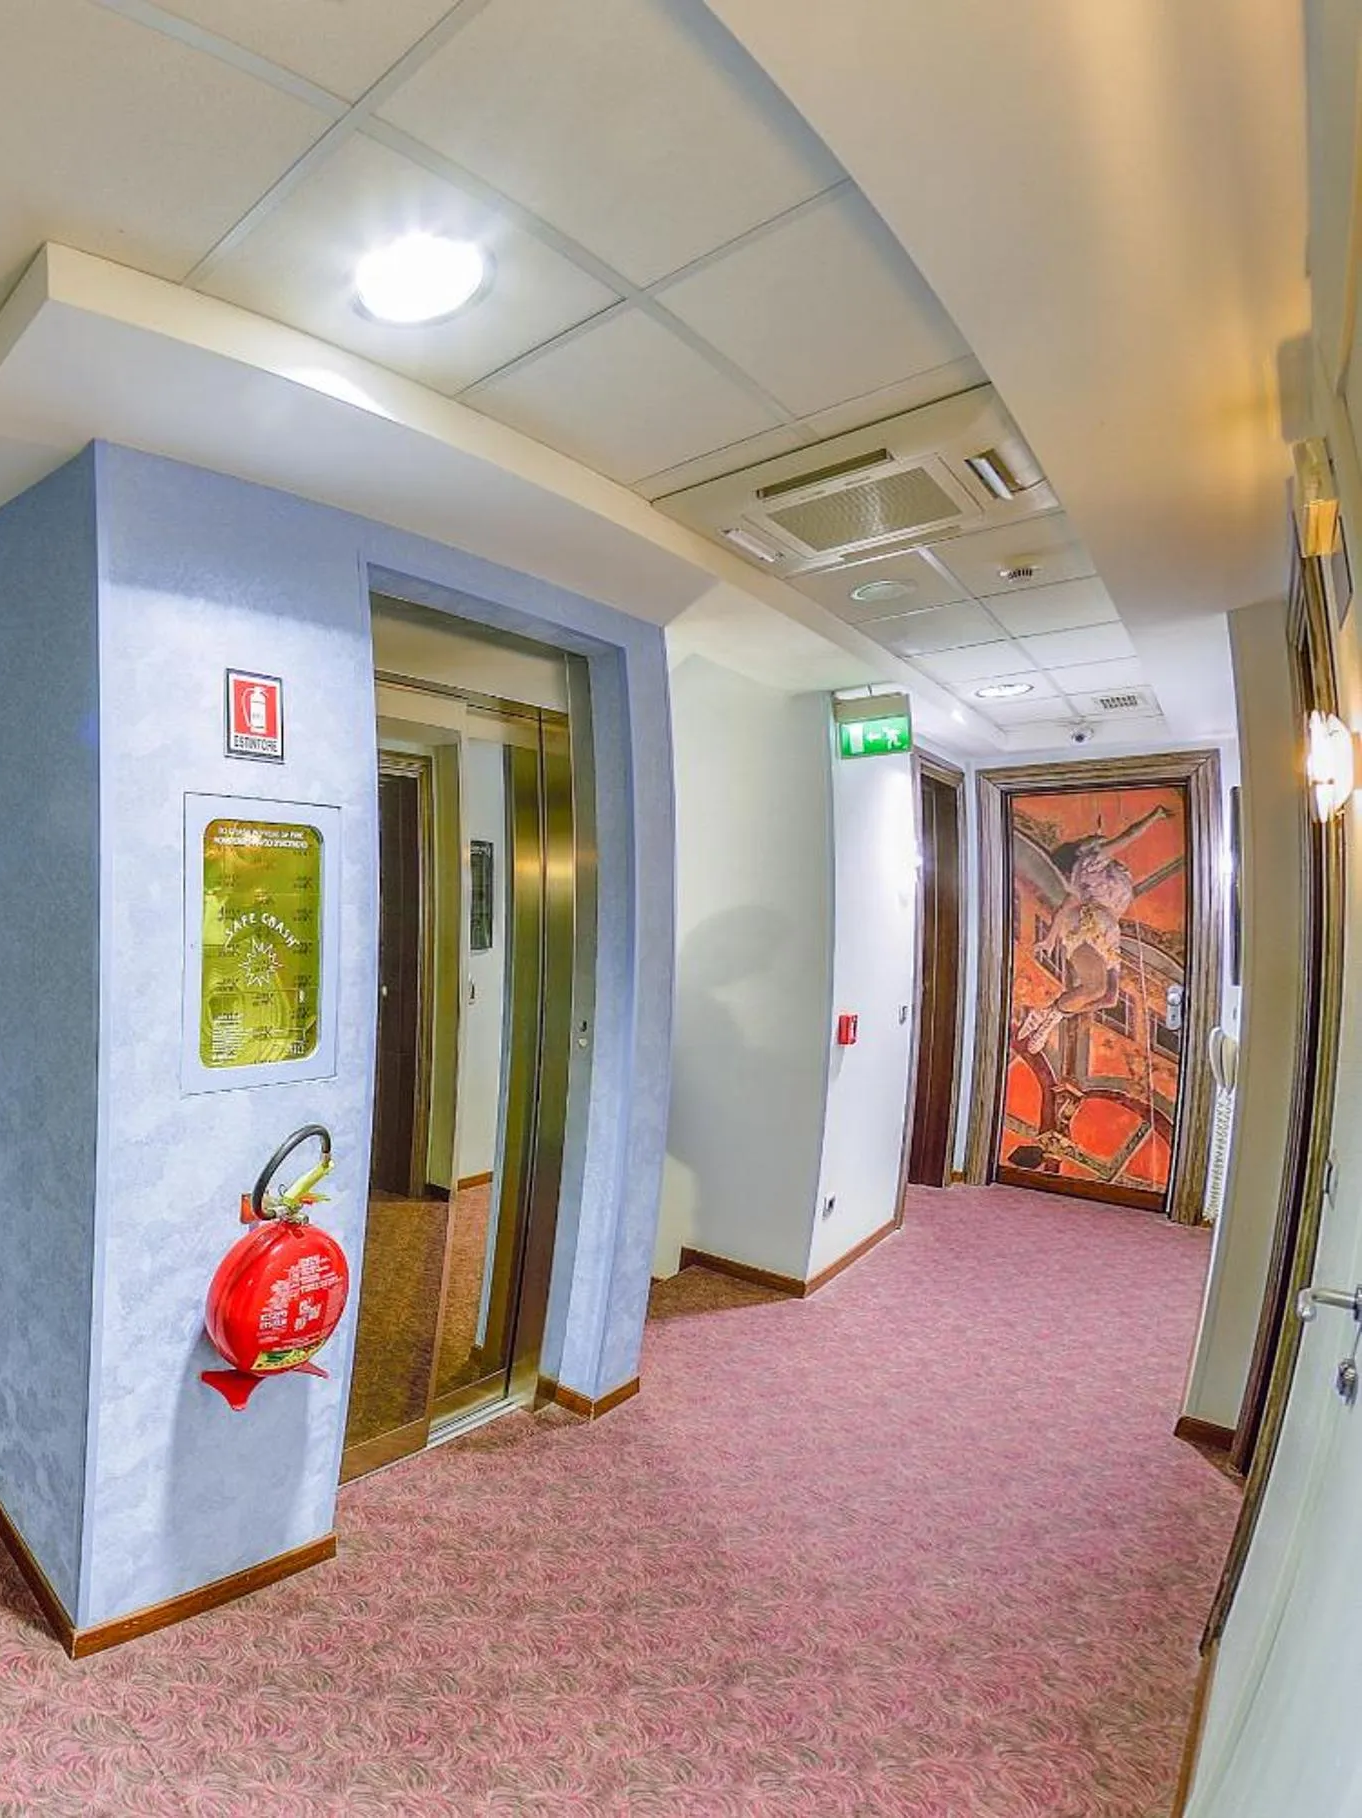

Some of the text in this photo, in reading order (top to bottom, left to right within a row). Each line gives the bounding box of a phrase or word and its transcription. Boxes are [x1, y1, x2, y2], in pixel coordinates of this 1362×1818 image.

[234, 735, 278, 752] ESTINTORE
[225, 912, 296, 948] SAFE CRASH
